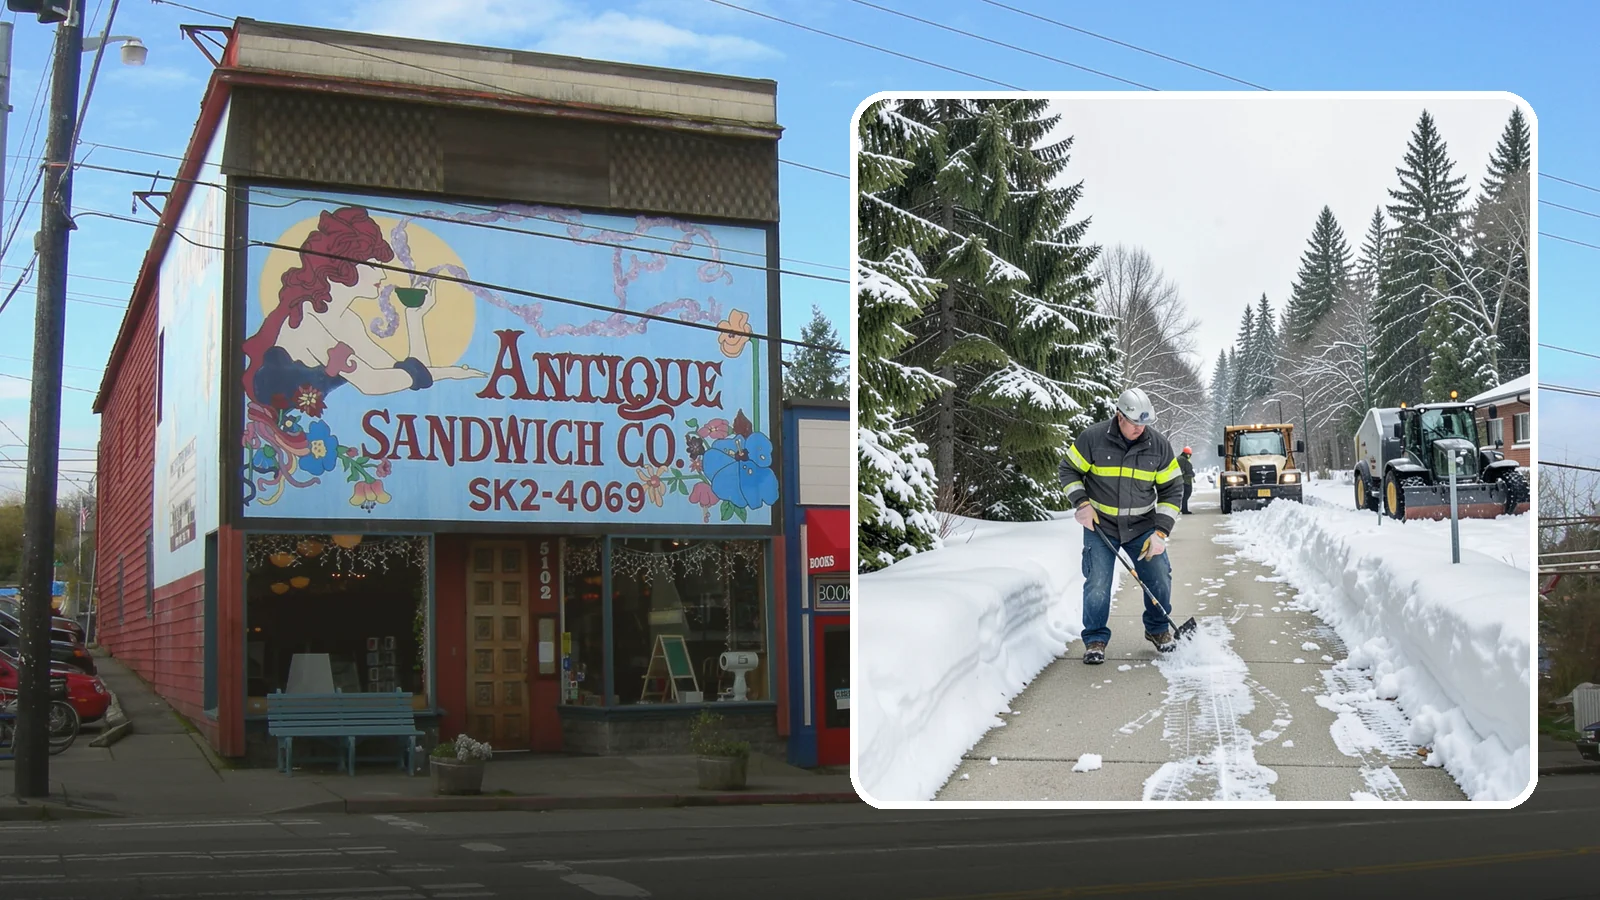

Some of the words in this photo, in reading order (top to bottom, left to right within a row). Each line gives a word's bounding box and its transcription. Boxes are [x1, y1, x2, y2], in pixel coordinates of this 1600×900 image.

[475, 329, 722, 421] ANTIQUE
[362, 409, 604, 467] SANDWICH
[617, 422, 685, 469] CO.
[469, 478, 646, 512] SK2-4069
[540, 541, 552, 600] 5102
[810, 555, 835, 569] BOOKS
